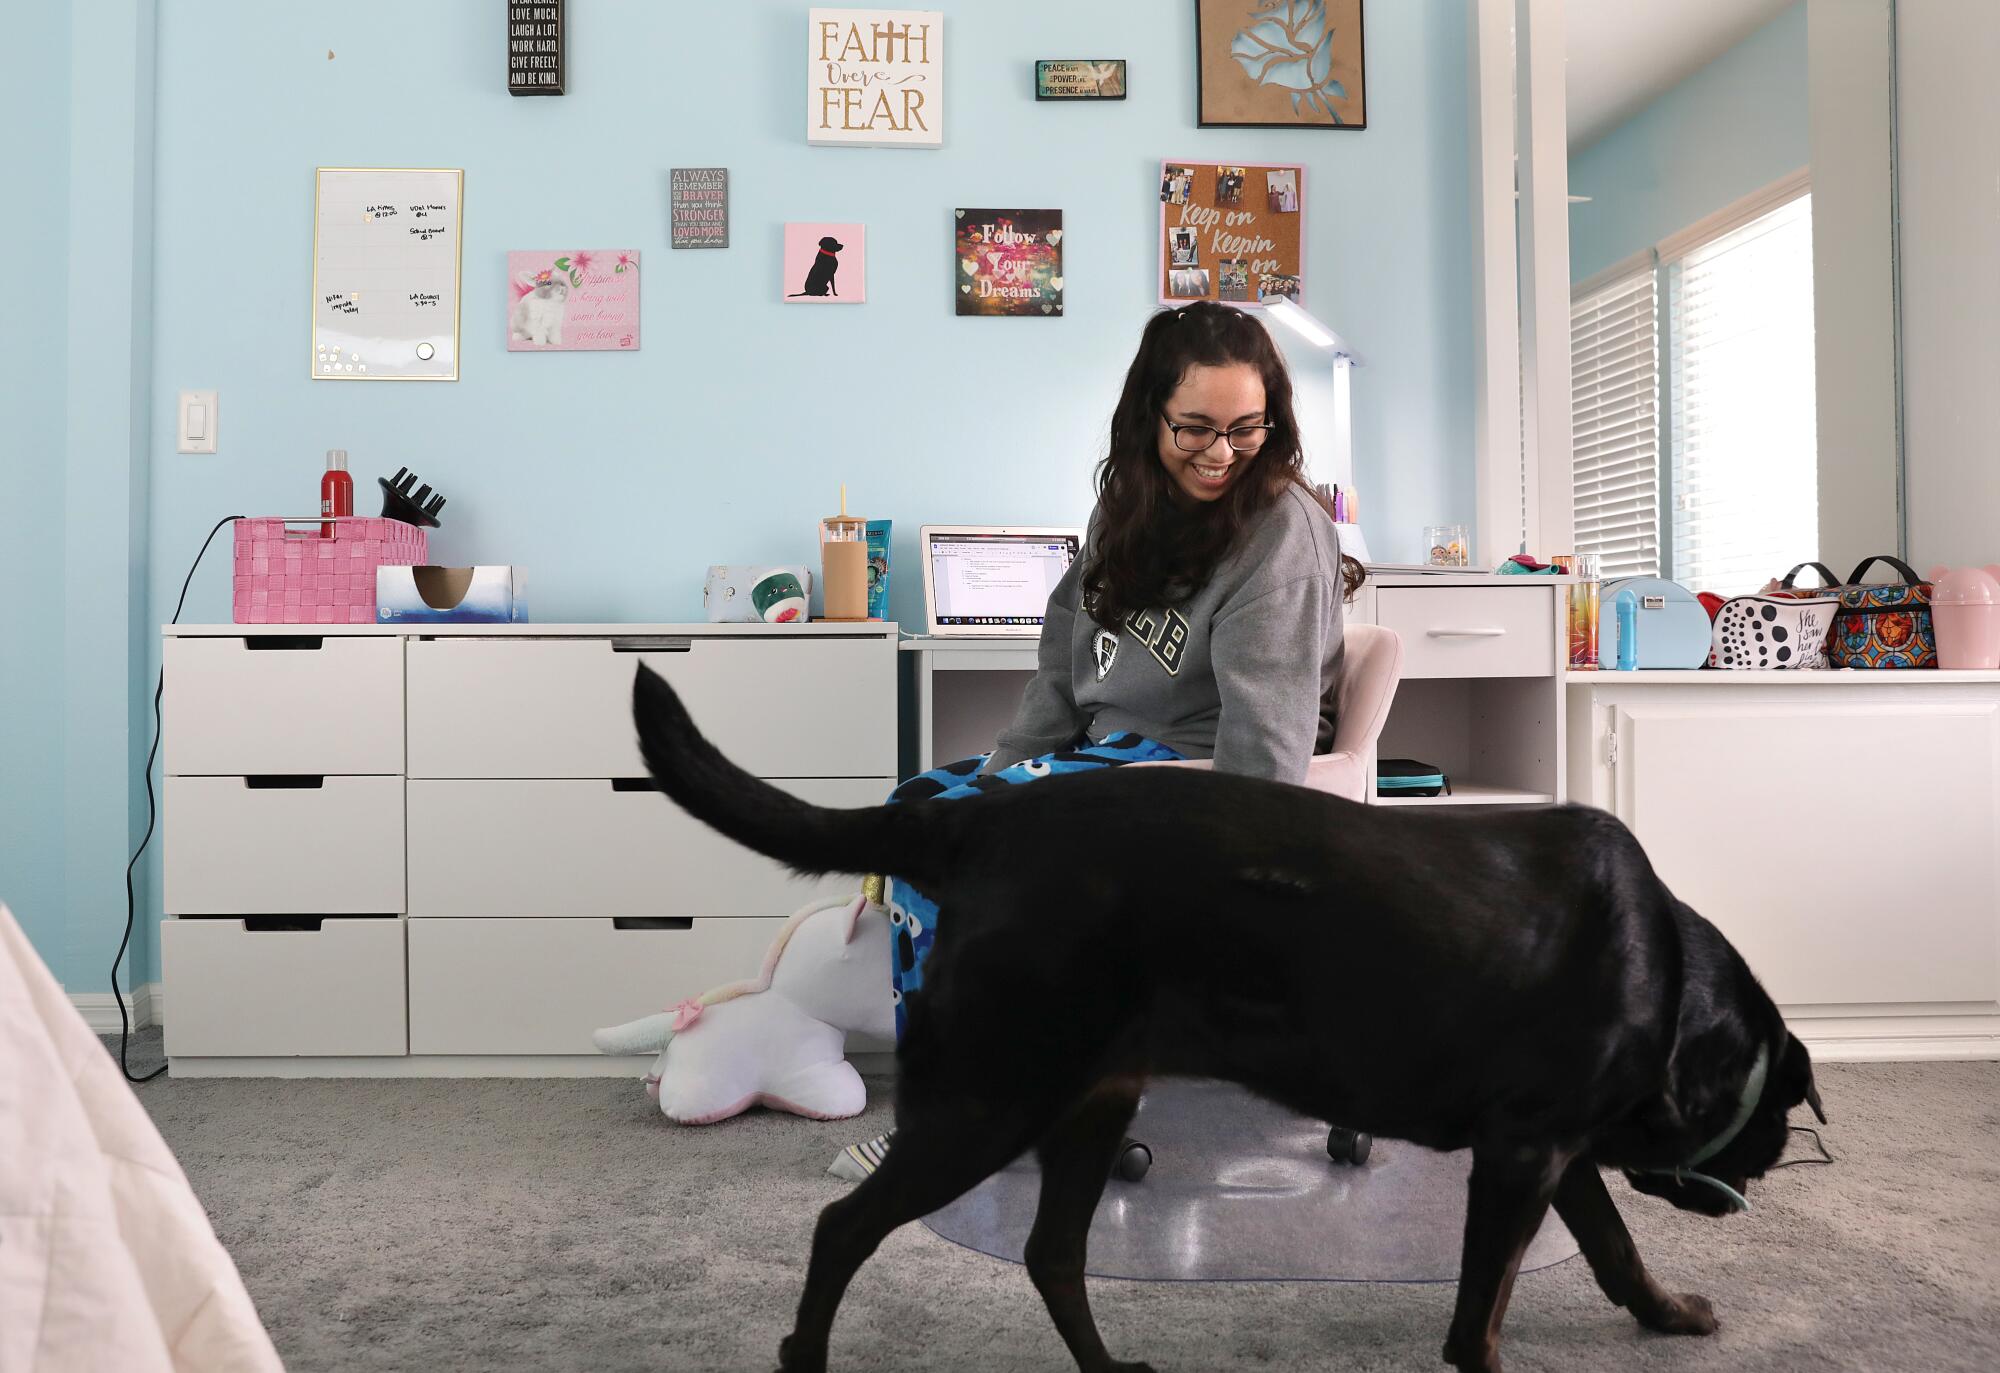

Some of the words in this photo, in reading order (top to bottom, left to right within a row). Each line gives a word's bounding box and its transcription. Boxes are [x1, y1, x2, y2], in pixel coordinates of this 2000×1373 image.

[511, 8, 531, 20] LOVE
[511, 24, 534, 37] LAUGH
[536, 24, 541, 37] A
[511, 40, 534, 52] WORK
[818, 20, 930, 64] FAITH
[511, 56, 528, 68] GIVE
[1043, 64, 1065, 72] PEACE
[511, 72, 526, 85] AND
[527, 72, 537, 85] BE
[827, 62, 893, 87] Over
[1053, 75, 1077, 83] POWER
[1045, 86, 1079, 94] PRESENCE
[819, 87, 929, 132] FEAR
[672, 170, 725, 182] ALWAYS
[672, 182, 723, 190] REMEMBER
[682, 190, 724, 201] BRAVER
[691, 203, 703, 211] you
[672, 209, 725, 222] STRONGER
[1179, 203, 1221, 234] Keep
[1225, 210, 1256, 227] on
[673, 226, 700, 237] LOVED
[701, 226, 724, 237] MORE
[981, 224, 1036, 244] Follow
[1210, 229, 1276, 261] Keepin
[986, 252, 1030, 271] Your
[1251, 258, 1282, 274] on
[979, 279, 1041, 297] Dreams
[1796, 609, 1818, 633] She
